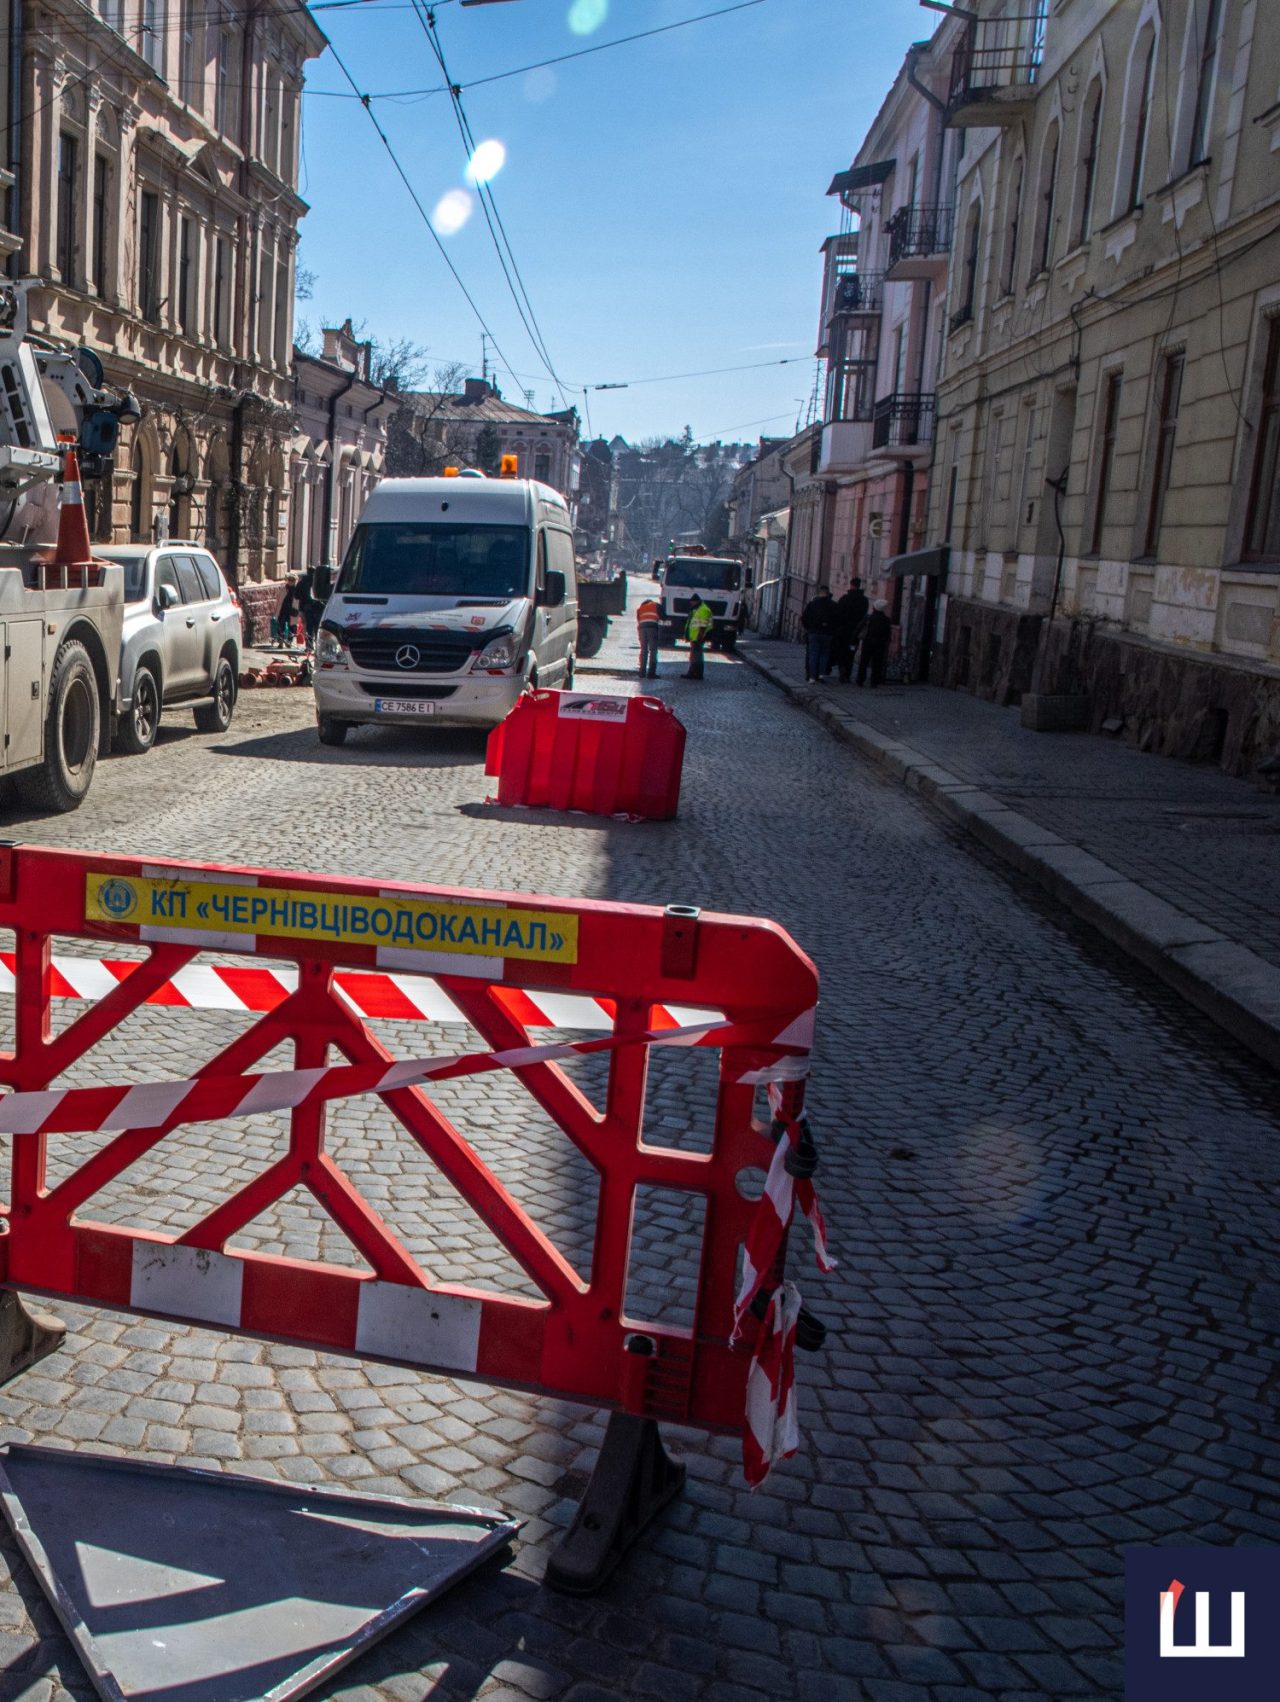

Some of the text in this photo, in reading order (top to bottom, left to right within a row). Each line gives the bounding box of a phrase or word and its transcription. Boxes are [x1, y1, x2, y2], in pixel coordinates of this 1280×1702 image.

[382, 701, 429, 713] CE 7586 EI
[151, 889, 564, 951] КП «ЧЕРНІВЦІВОДОКАНАЛ»
